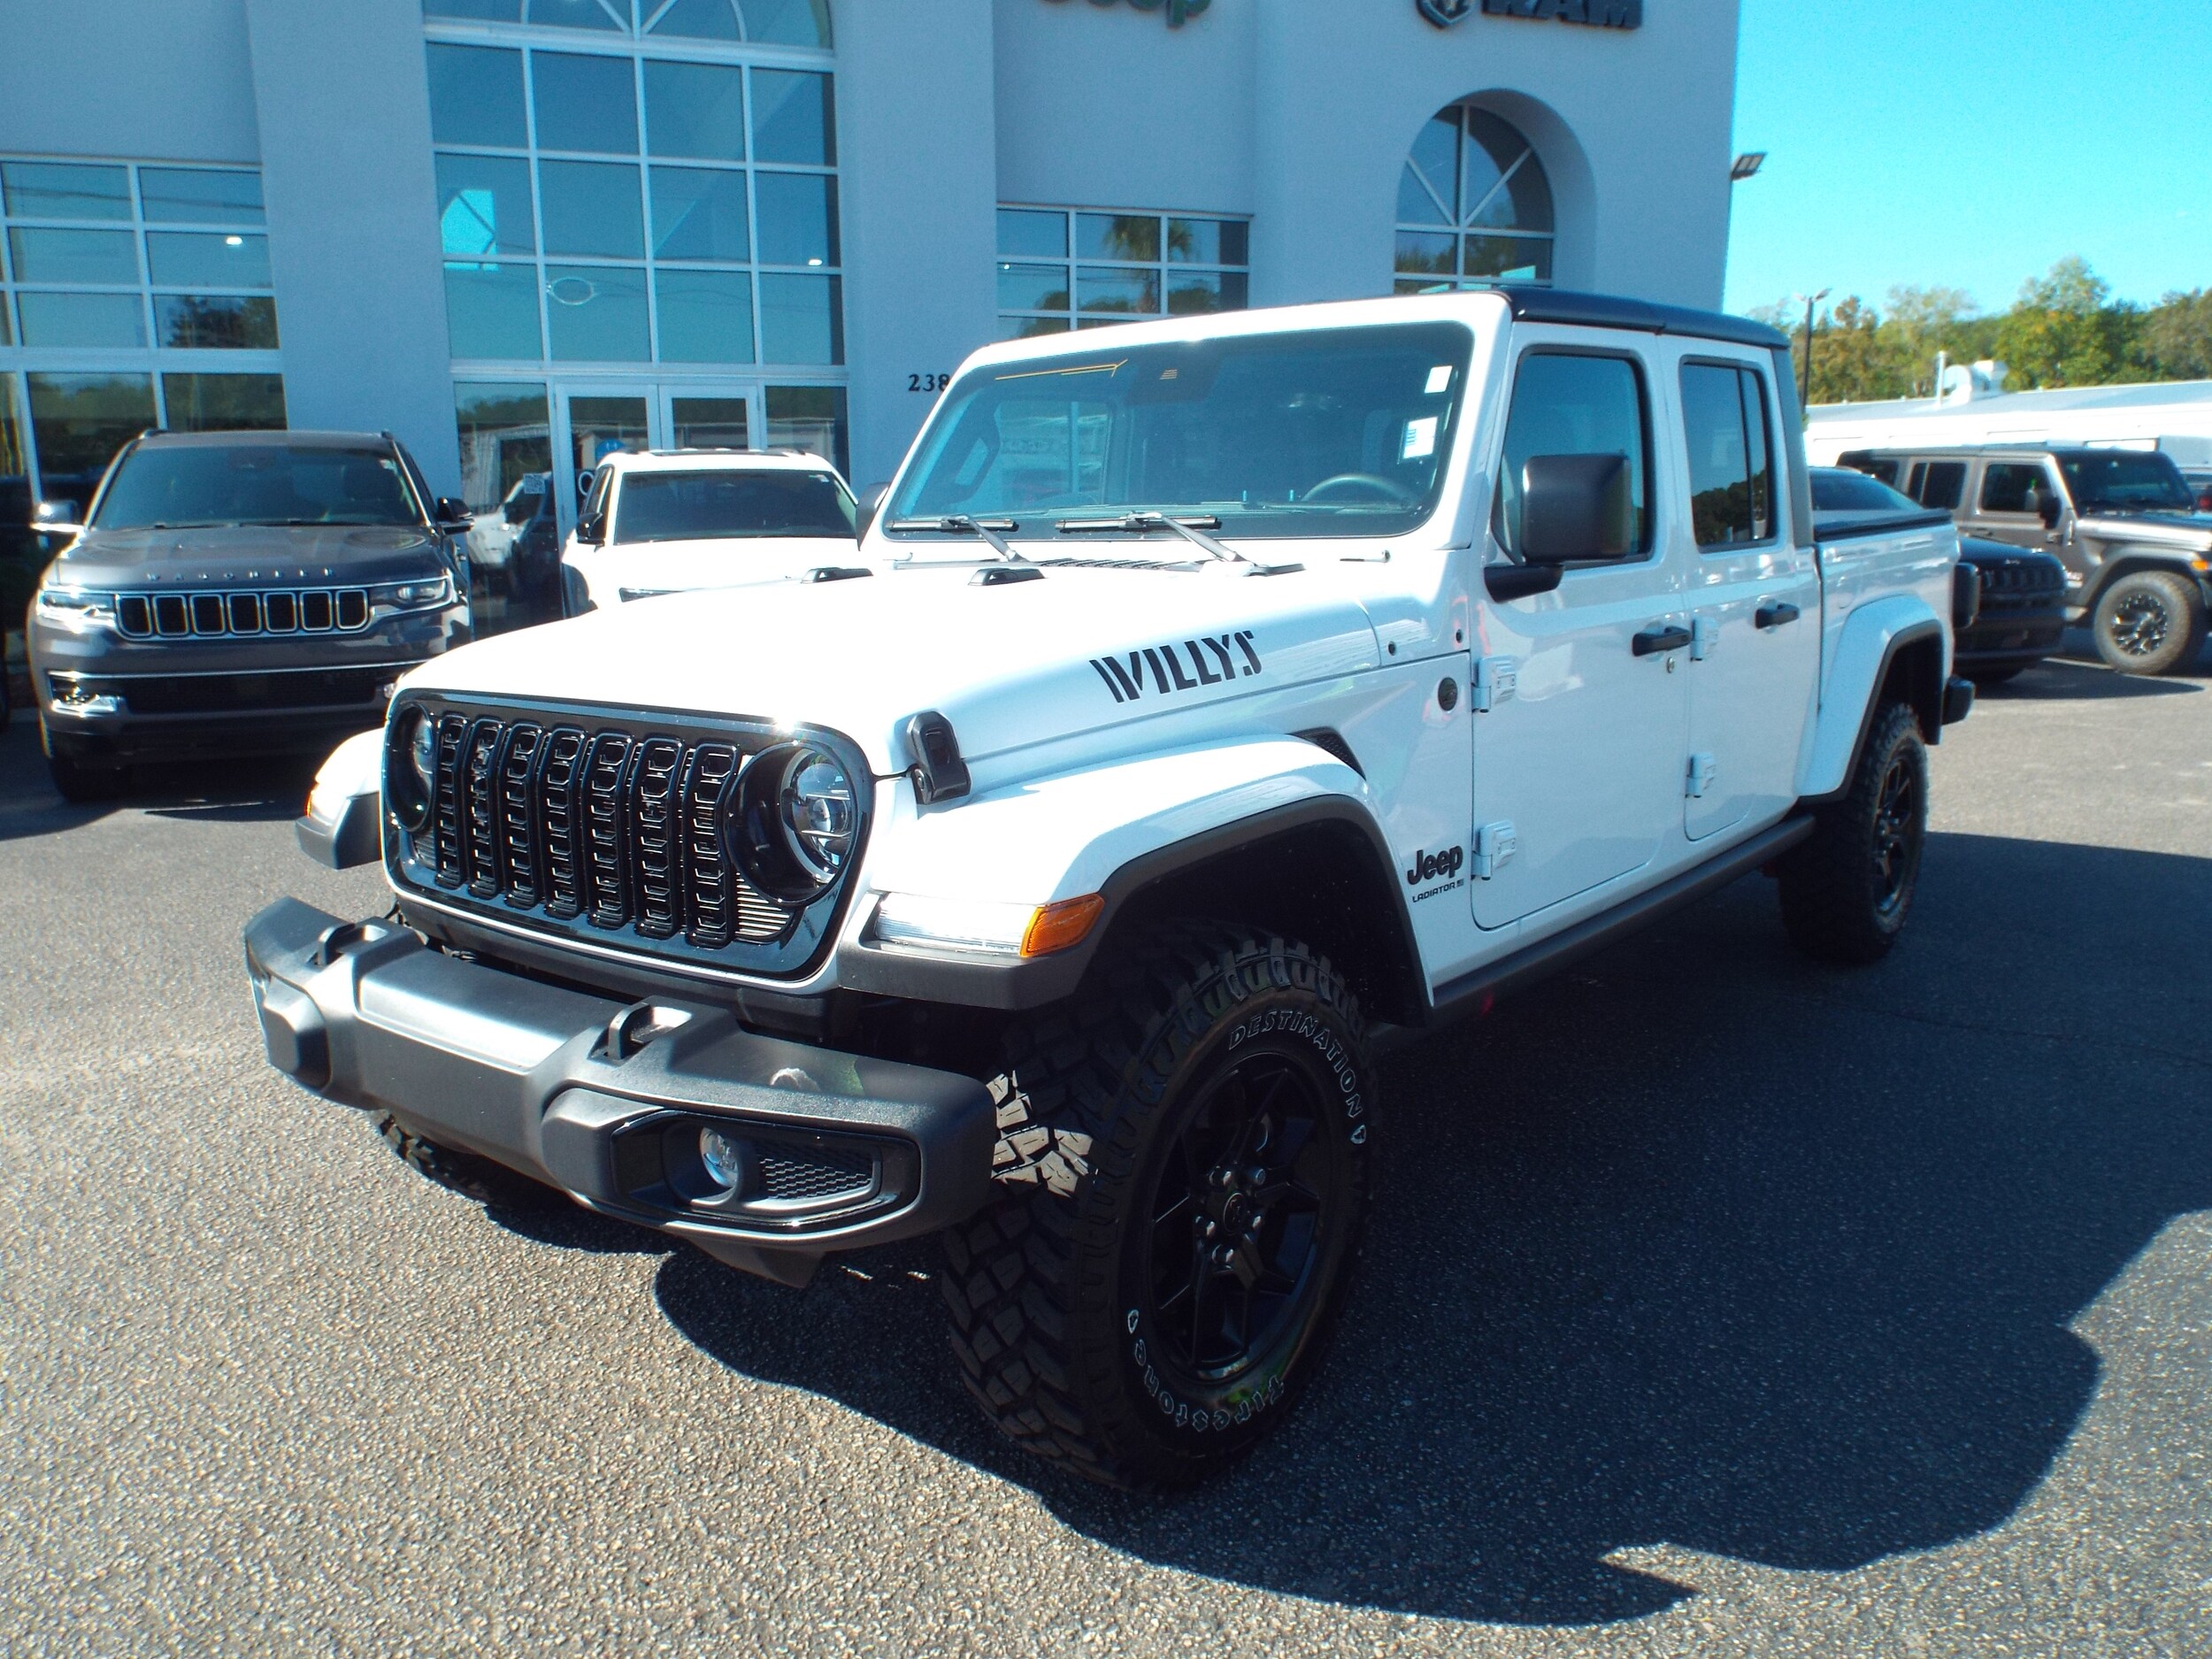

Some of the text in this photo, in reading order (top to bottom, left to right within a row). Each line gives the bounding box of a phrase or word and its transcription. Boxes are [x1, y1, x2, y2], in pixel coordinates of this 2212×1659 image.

[1088, 630, 1263, 703] WILLYS
[1407, 845, 1463, 886] Jeep
[1228, 1010, 1363, 1119] DESTINATION
